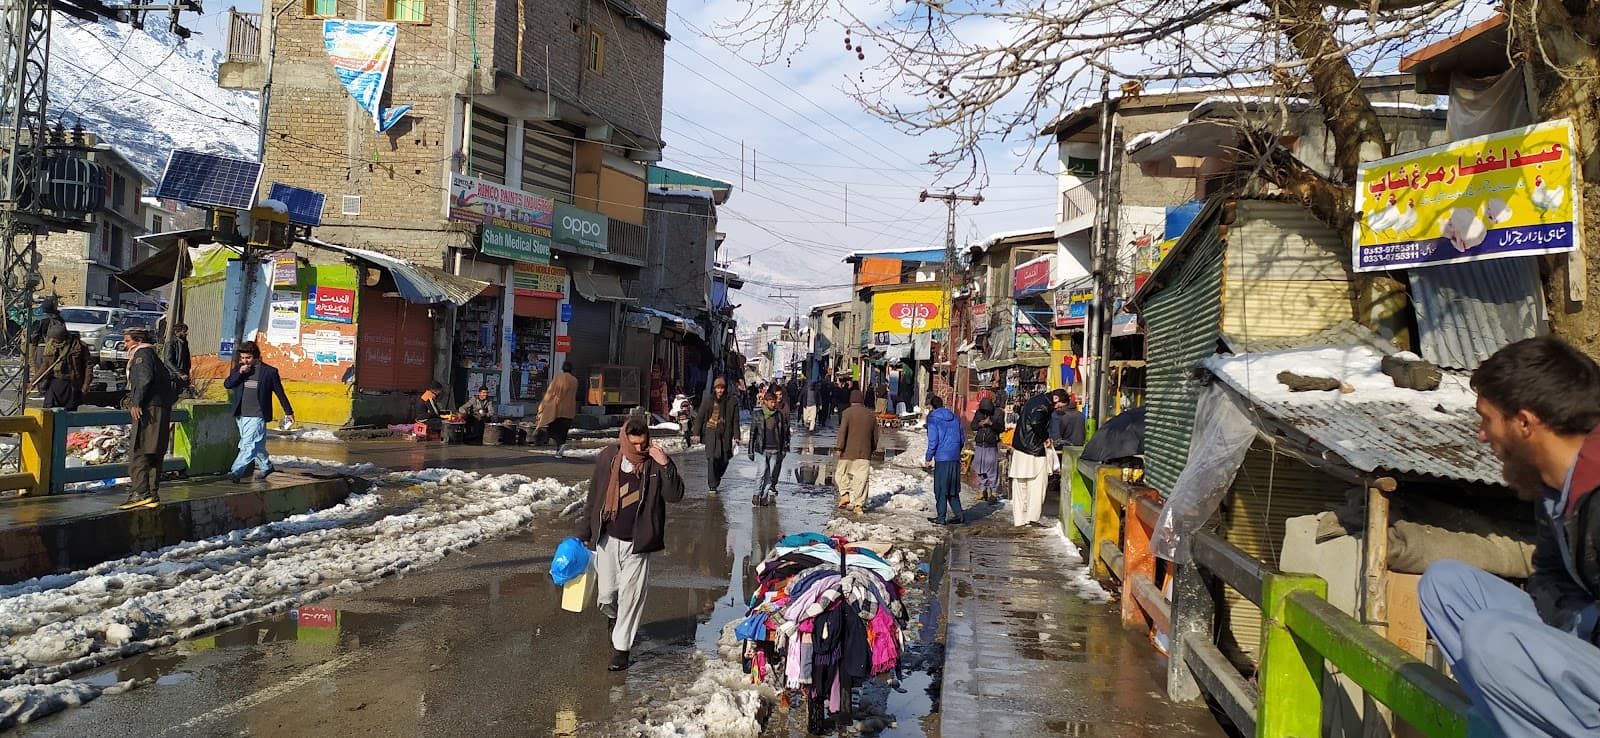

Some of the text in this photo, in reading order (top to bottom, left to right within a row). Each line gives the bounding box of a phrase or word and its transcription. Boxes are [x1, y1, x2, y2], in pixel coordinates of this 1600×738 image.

[1369, 166, 1410, 201] شاپ
[500, 188, 523, 207] PAINTS
[562, 216, 600, 237] oppo
[1544, 227, 1567, 242] شاہی
[485, 229, 550, 255] Shah Medical Store
[1523, 231, 1543, 244] بازار
[320, 294, 350, 304] الخدمت
